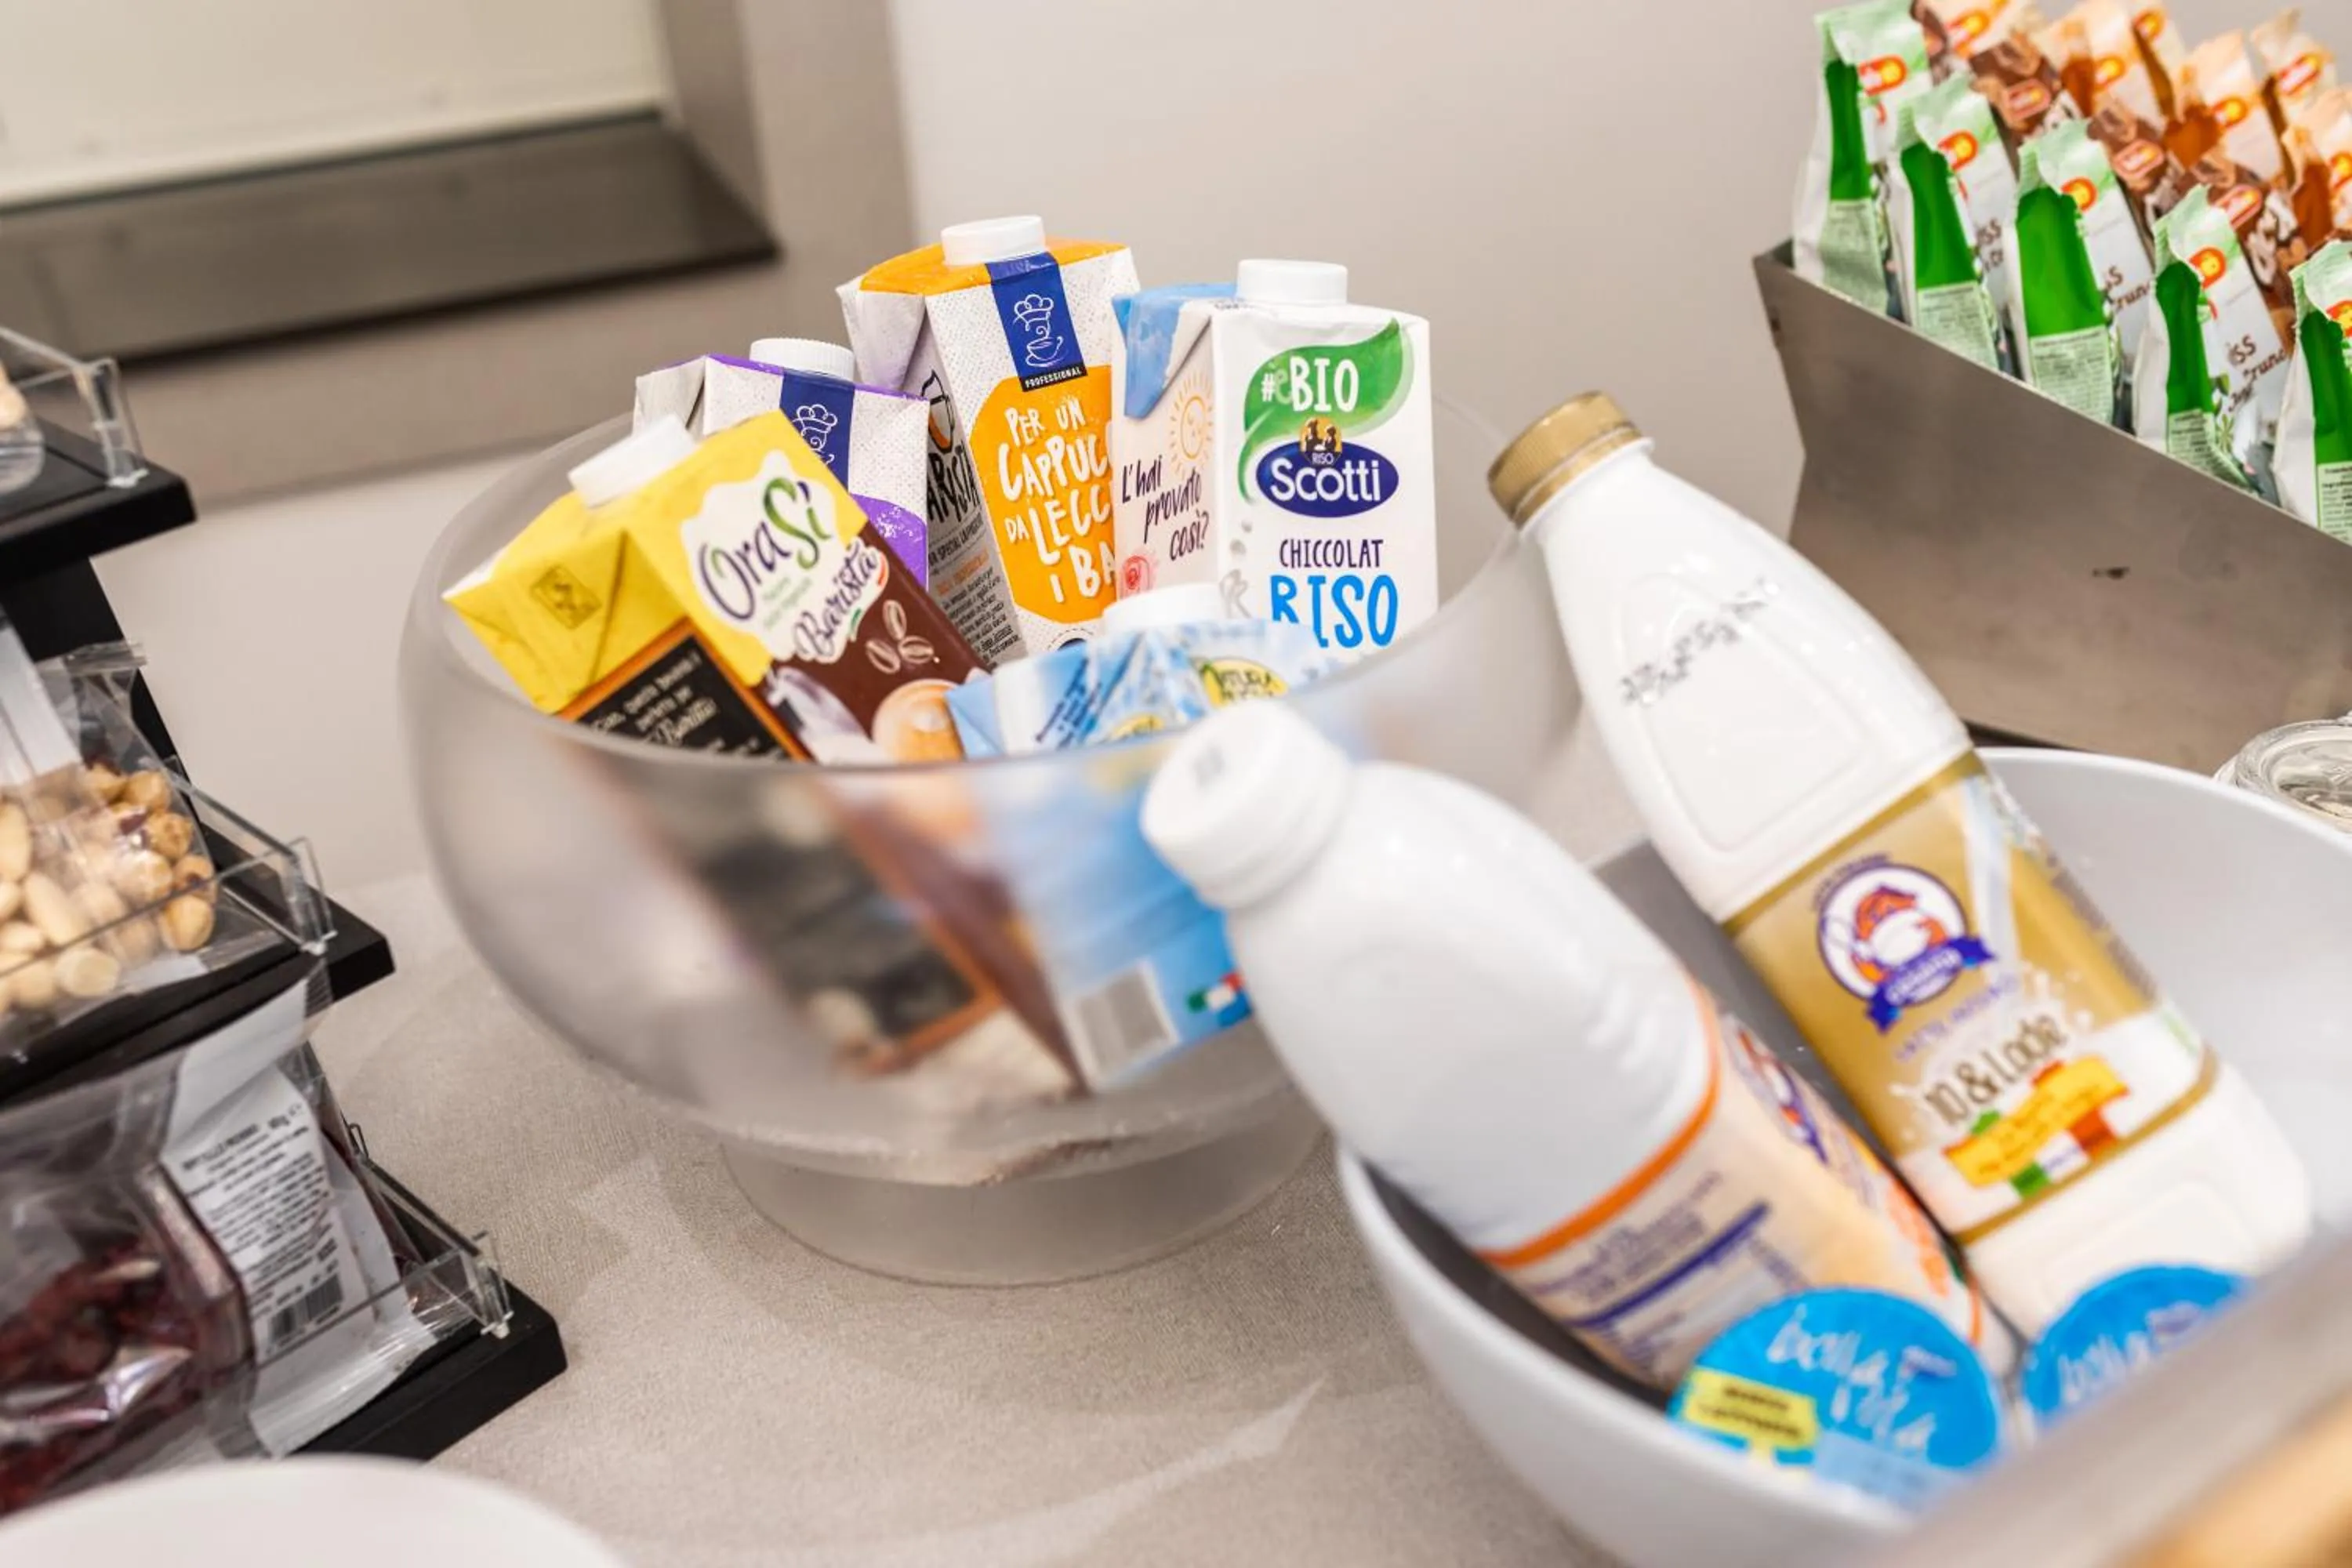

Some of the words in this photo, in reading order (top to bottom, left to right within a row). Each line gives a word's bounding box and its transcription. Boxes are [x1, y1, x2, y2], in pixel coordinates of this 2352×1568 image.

[1025, 368, 1082, 389] PROFESSIONAL
[1004, 407, 1045, 447] PER
[1055, 397, 1086, 430] UN
[998, 434, 1112, 501] CAPPUC
[1122, 454, 1163, 504] L'hai
[1270, 456, 1381, 501] Scotti
[1312, 452, 1334, 465] RISO
[1004, 514, 1029, 543] DA
[1144, 466, 1202, 544] provato
[1279, 539, 1384, 568] CHICCOLAT
[793, 539, 878, 656] Barista
[1270, 574, 1398, 648] RISO
